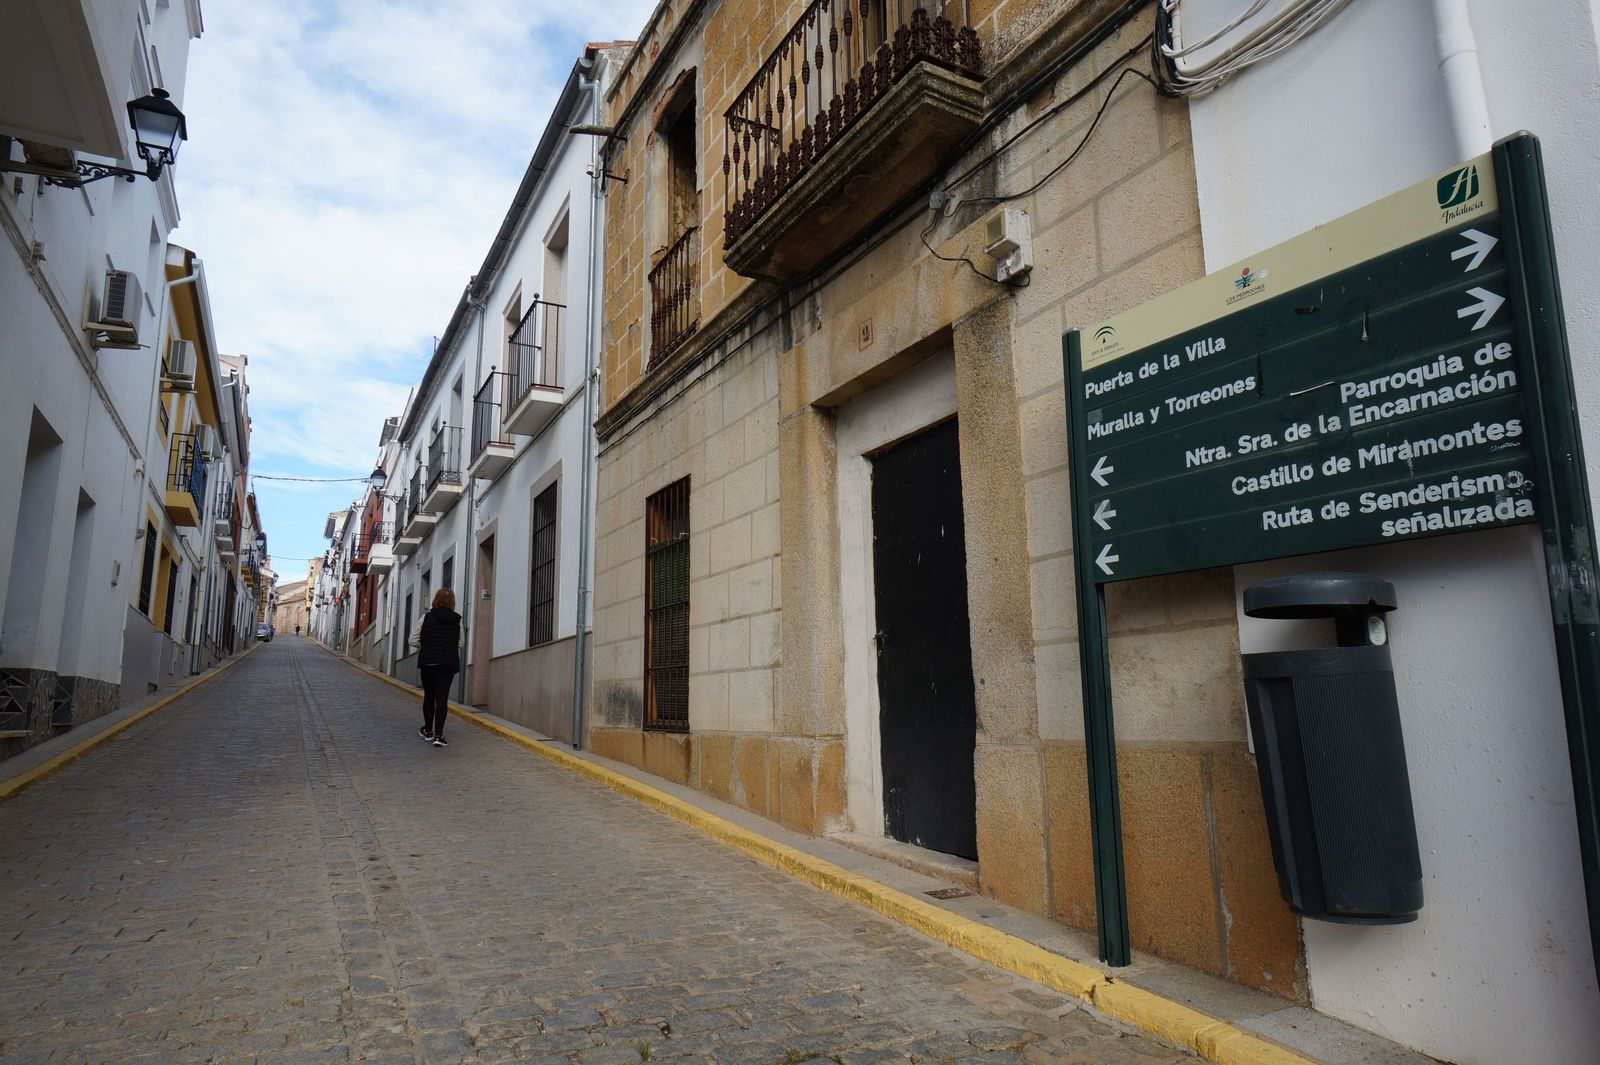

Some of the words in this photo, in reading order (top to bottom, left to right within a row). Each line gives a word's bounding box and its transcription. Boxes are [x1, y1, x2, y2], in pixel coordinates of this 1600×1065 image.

[1085, 371, 1134, 400] Puerta
[1138, 362, 1159, 381] de
[1163, 354, 1181, 374] la
[1185, 337, 1227, 362] Villa
[1340, 354, 1465, 404] Parroquia
[1474, 341, 1513, 366] de
[1087, 412, 1145, 441] Muralla
[1149, 406, 1160, 425] y
[1165, 376, 1257, 415] Torreones
[1185, 445, 1232, 468] Ntra.
[1237, 433, 1278, 455] Sra.
[1284, 422, 1312, 443] de
[1318, 414, 1342, 434] la
[1348, 369, 1517, 427] Encarnación
[1231, 463, 1314, 496] Castillo
[1321, 455, 1352, 476] de
[1358, 419, 1523, 469] Miramontes
[1262, 505, 1314, 531] Ruta
[1320, 499, 1350, 520] de
[1359, 470, 1525, 514] Senderismo
[1381, 496, 1536, 537] señalizada
